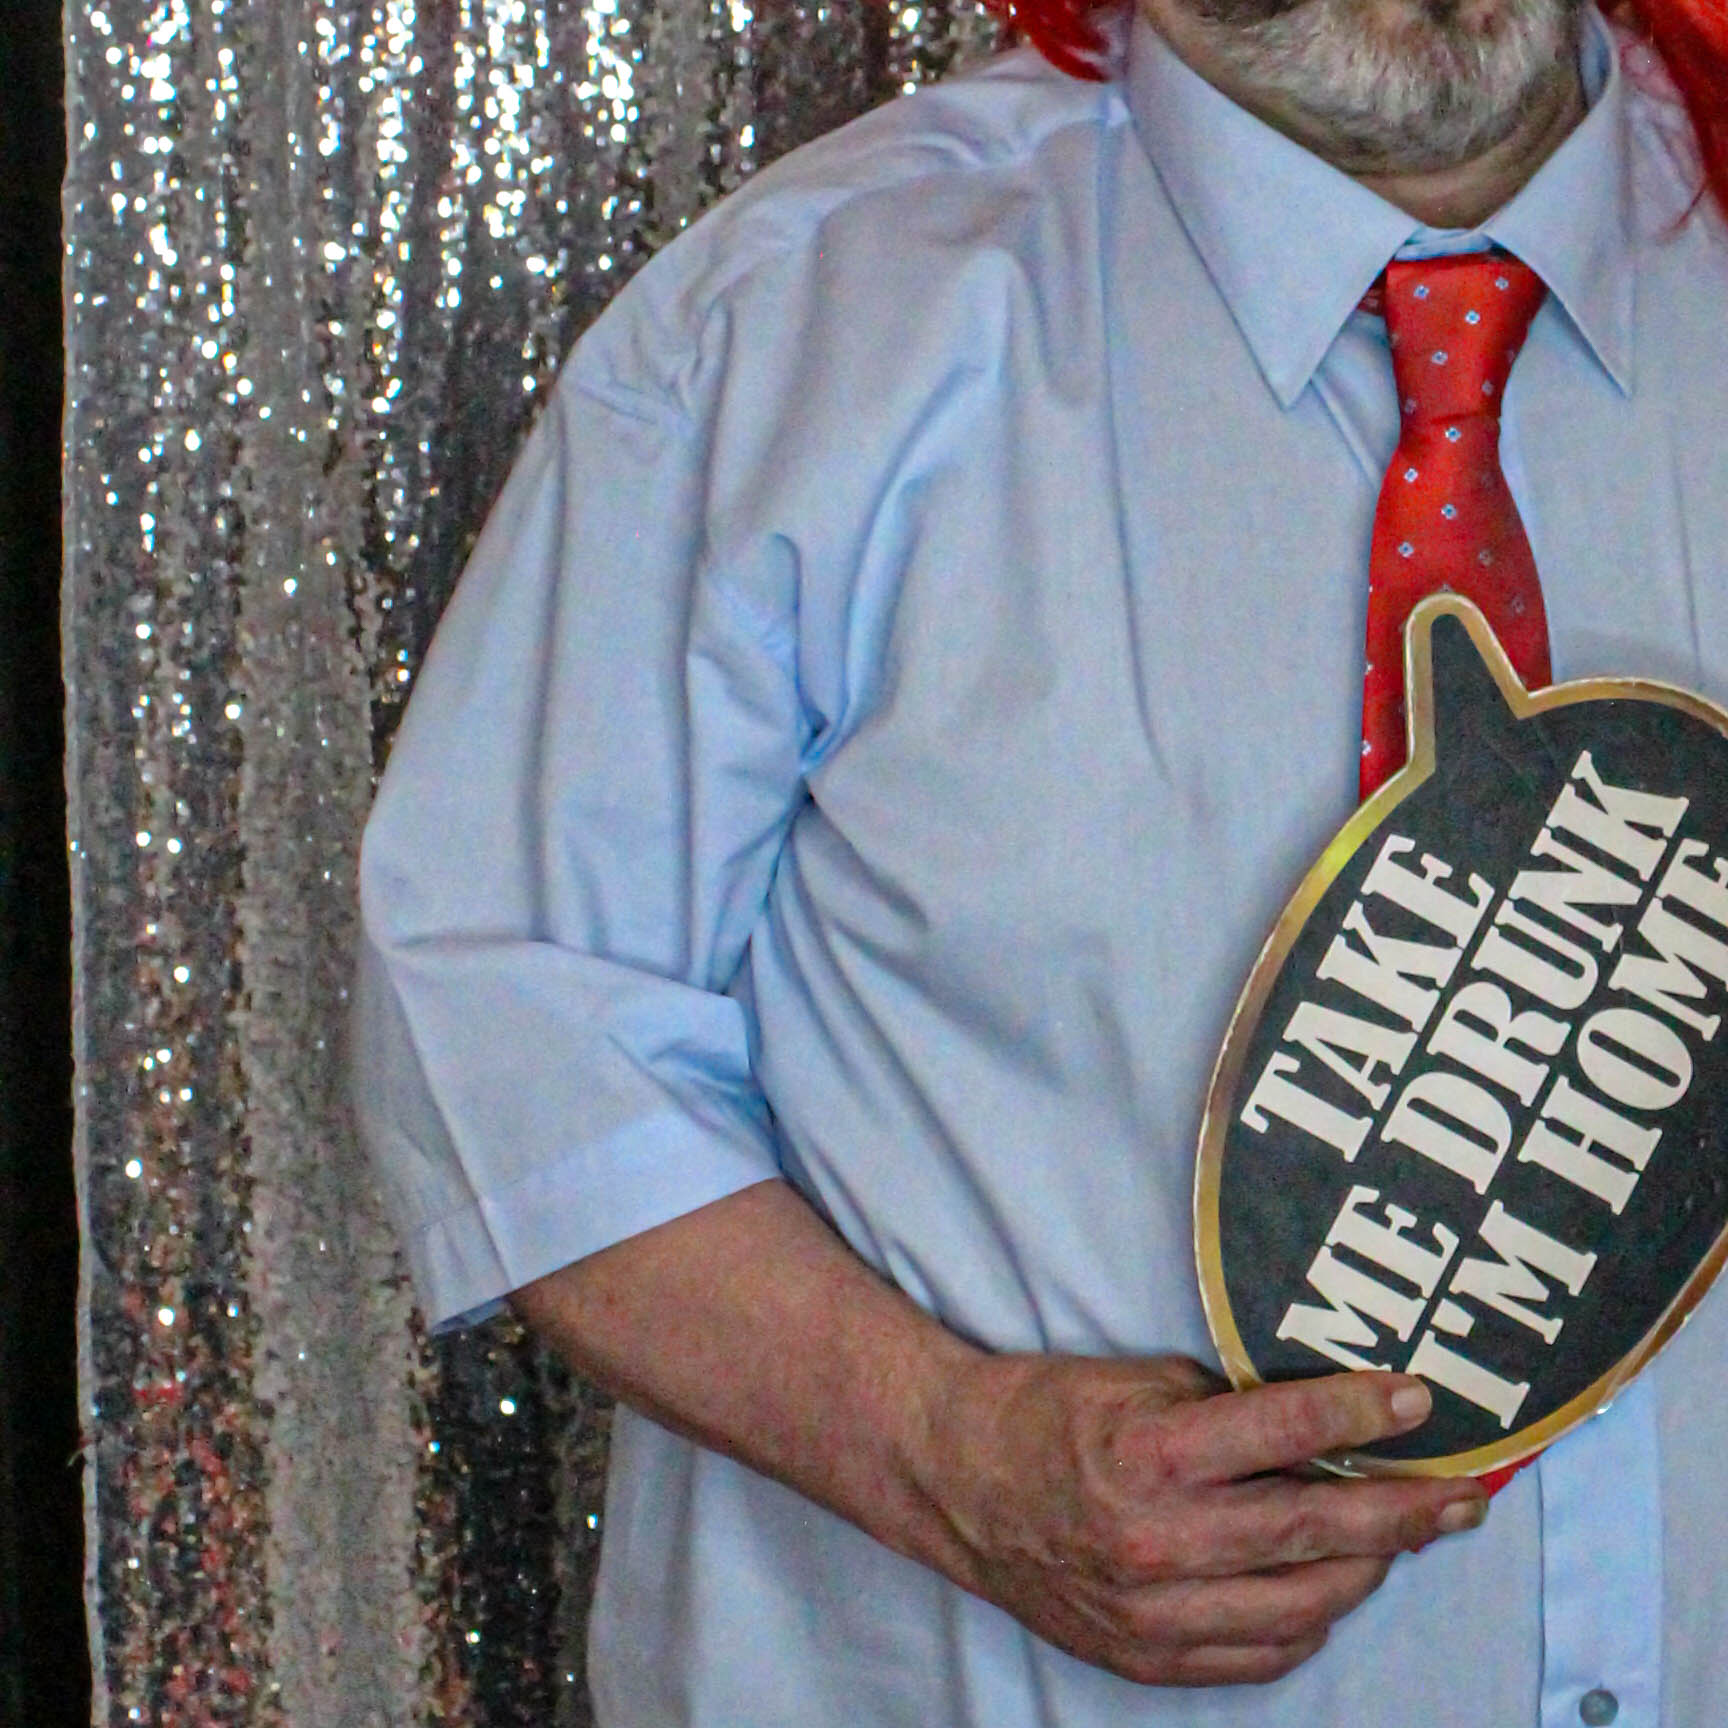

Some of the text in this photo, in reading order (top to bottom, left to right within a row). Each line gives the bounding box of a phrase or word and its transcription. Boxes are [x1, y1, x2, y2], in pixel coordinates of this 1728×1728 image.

[1241, 835, 1494, 1162] TAKE
[1277, 750, 1689, 1373] ME DRUNK
[1406, 1200, 1597, 1429] I'M
